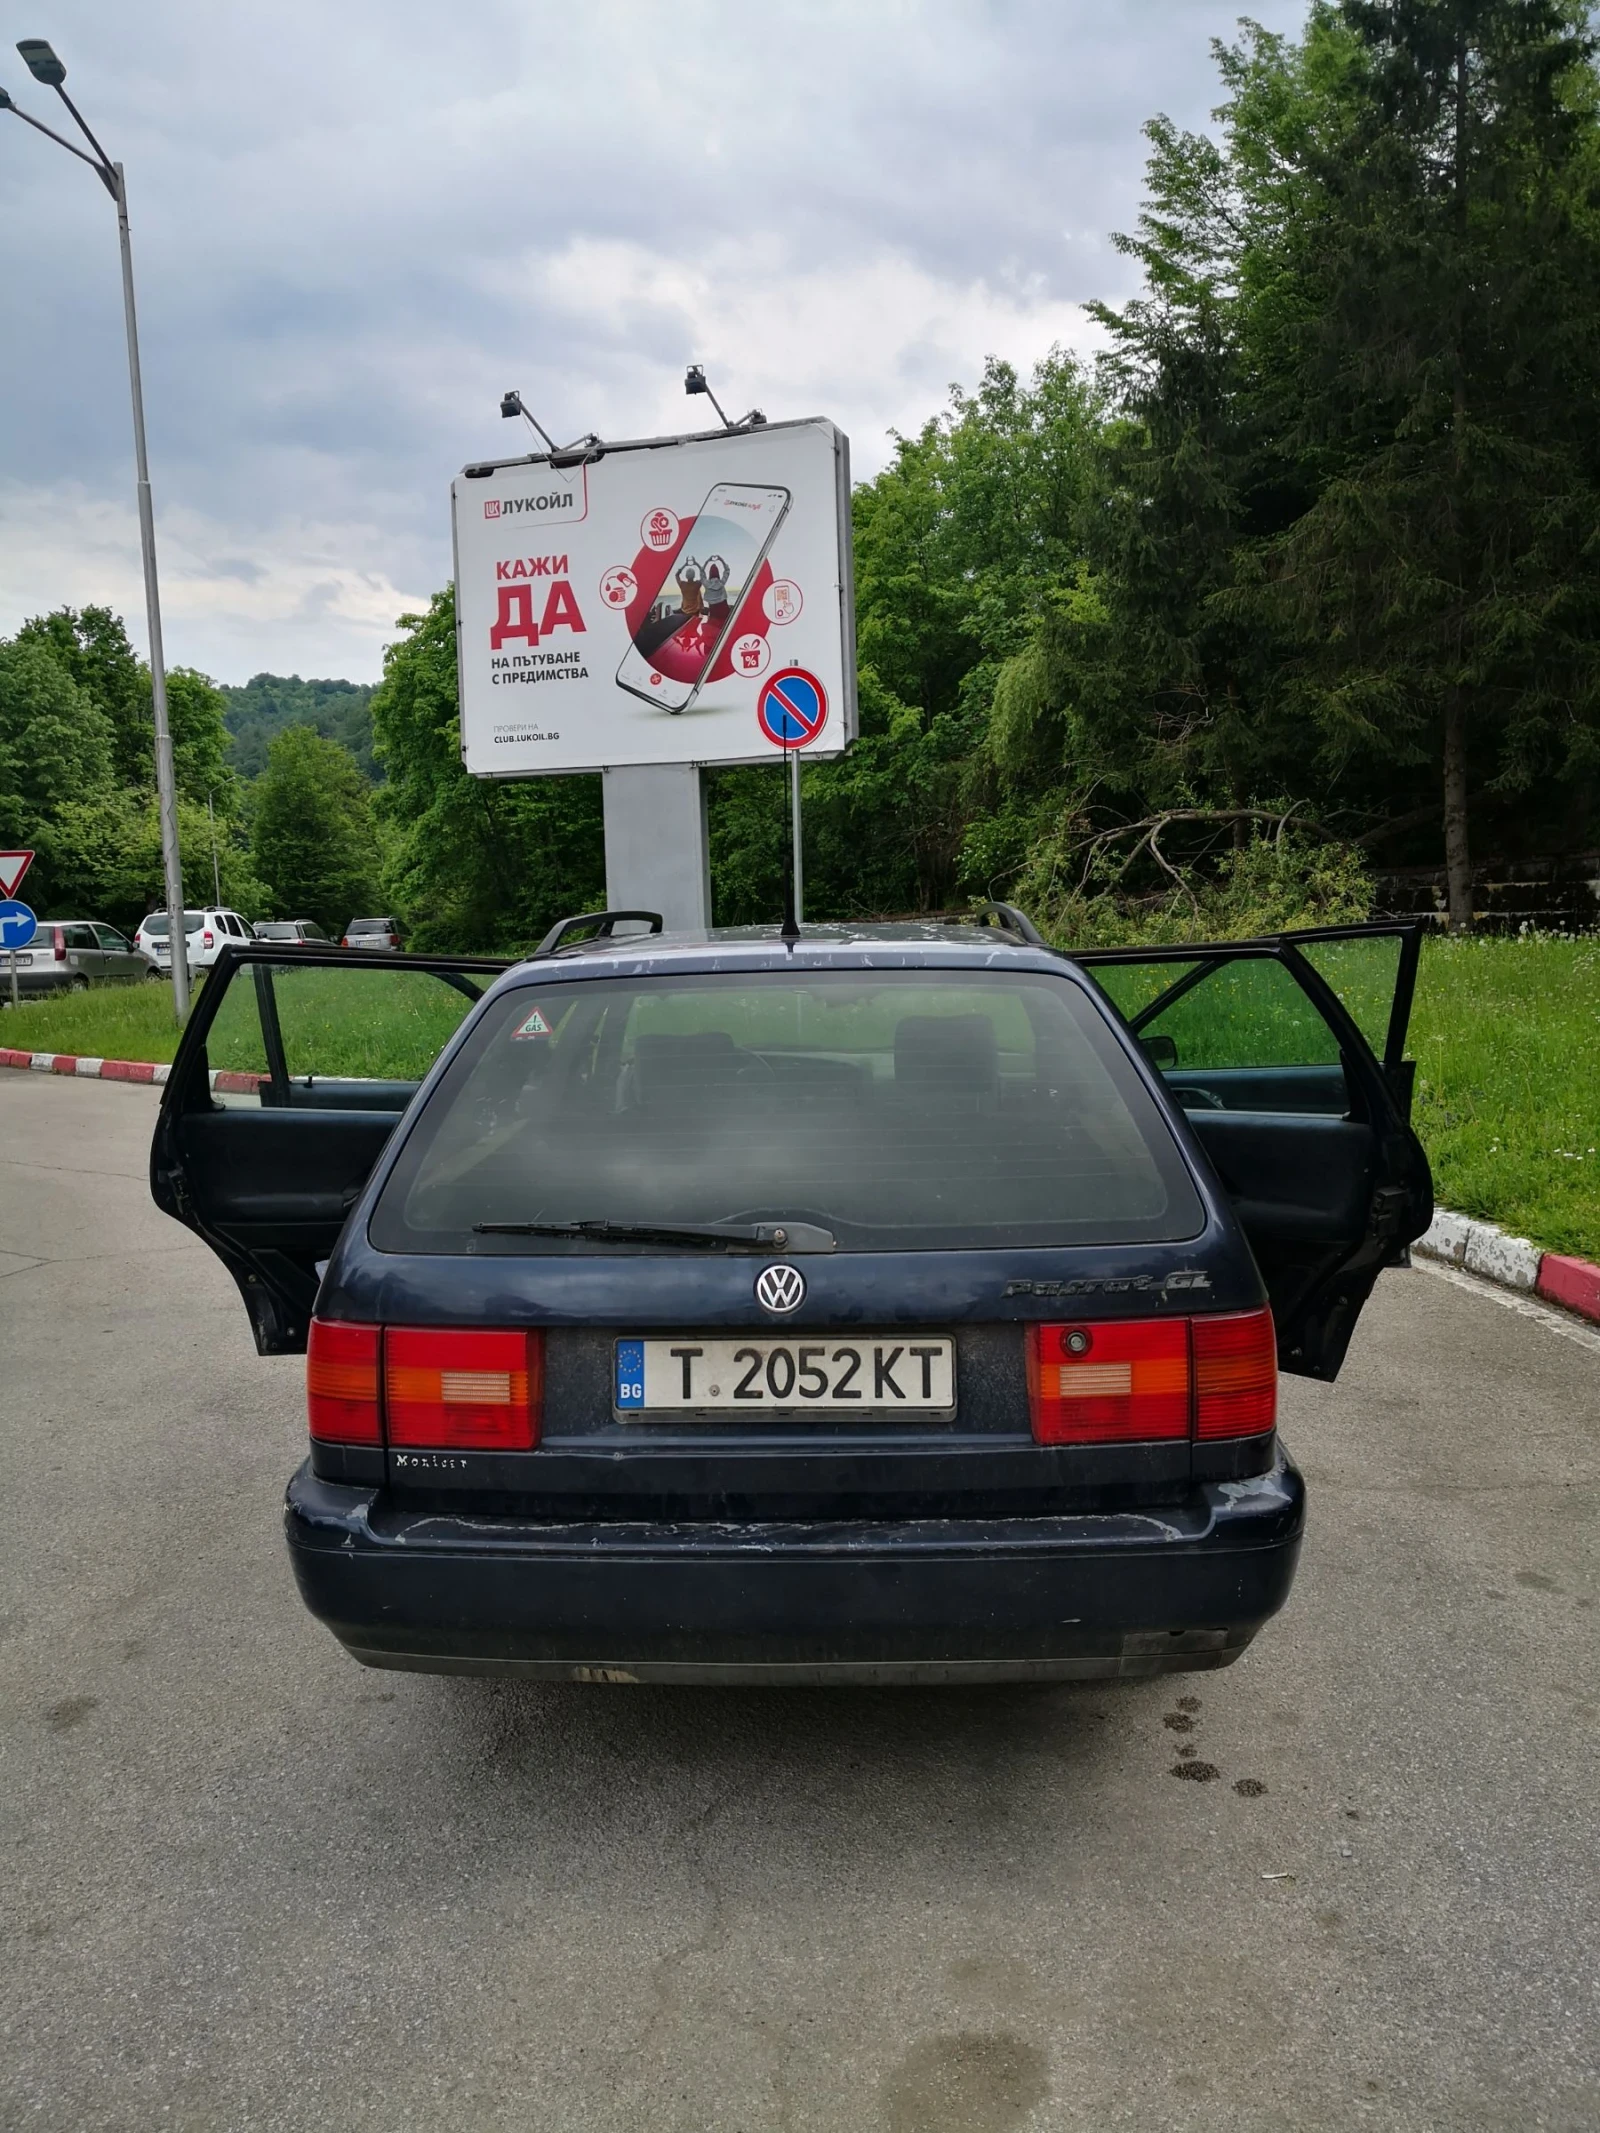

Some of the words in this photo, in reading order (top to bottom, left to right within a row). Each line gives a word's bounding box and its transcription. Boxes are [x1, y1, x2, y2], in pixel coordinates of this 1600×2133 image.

[502, 491, 573, 515] ЛУКОЙЛ
[496, 554, 569, 581] КАЖИ
[490, 580, 587, 650] ДА
[491, 657, 510, 669] НА
[512, 651, 581, 668] ПЪТУВАНЕ
[491, 674, 500, 685] С
[502, 667, 589, 684] ПРЕДИМСТВА
[493, 725, 527, 734] ПРОВЕРИ
[528, 723, 539, 731] НА
[494, 732, 560, 744] CLUB.LUKOIL.BG
[525, 1024, 542, 1032] GAS
[620, 1383, 642, 1399] BG
[670, 1347, 703, 1399] T
